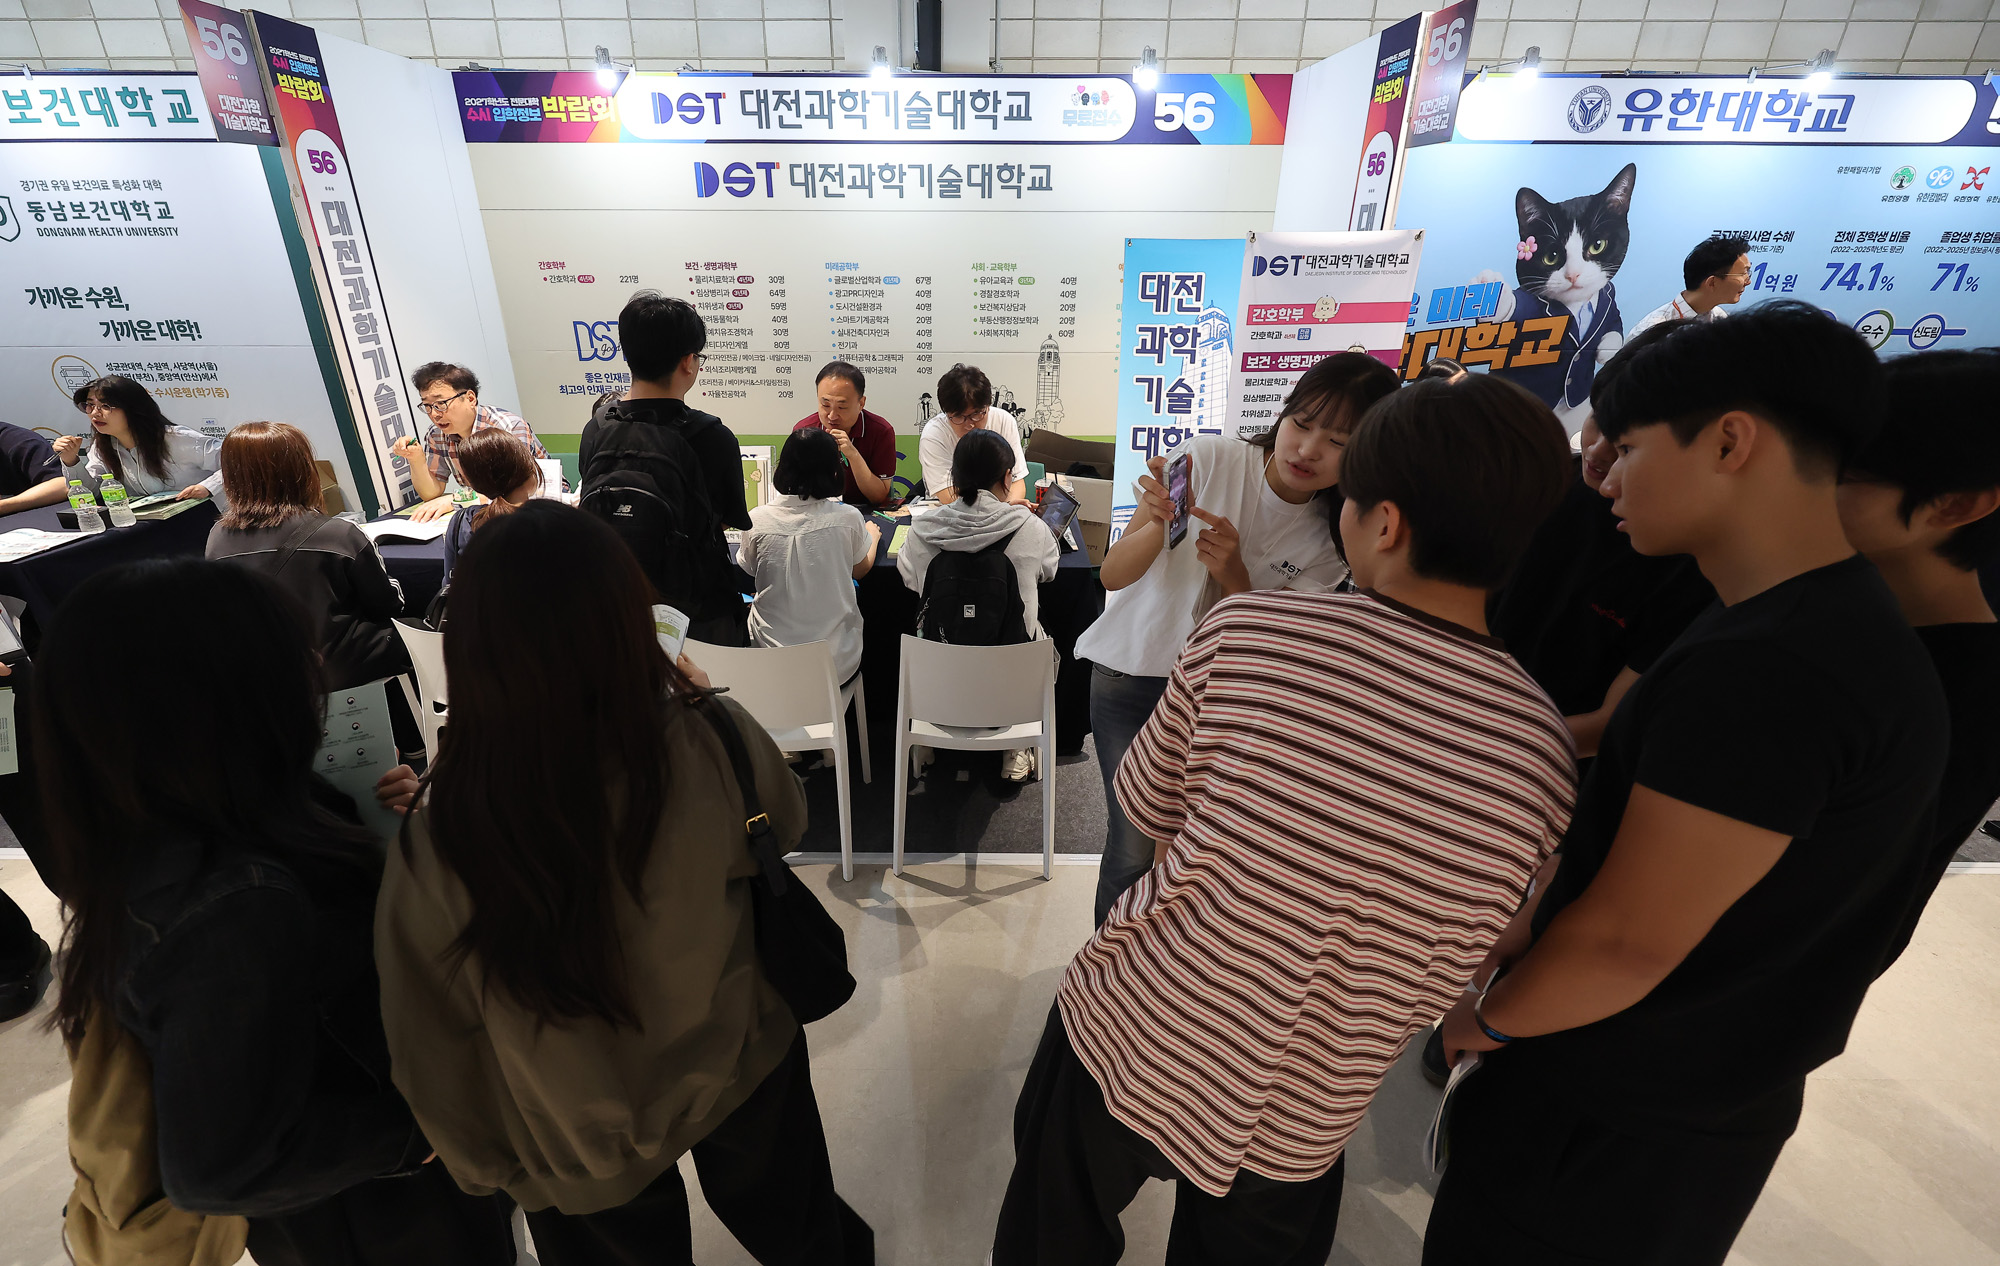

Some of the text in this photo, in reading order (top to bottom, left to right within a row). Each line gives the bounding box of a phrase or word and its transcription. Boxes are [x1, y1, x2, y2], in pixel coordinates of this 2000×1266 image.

[195, 16, 248, 65] 56
[1428, 18, 1465, 67] 56
[273, 56, 320, 77] 수시 입학정보
[1378, 65, 1389, 79] 수시
[276, 73, 325, 103] 박람회
[1374, 75, 1405, 105] 박람회
[2, 87, 200, 128] 보건대학교
[218, 94, 262, 116] 대전과학
[510, 98, 540, 107] 전문대학
[1418, 94, 1449, 117] 대전과학
[467, 107, 542, 122] 수시 입학정보
[541, 96, 617, 123] 박람회
[651, 88, 1032, 130] DST 대전과학기술대학교
[1153, 92, 1216, 132] 56
[1617, 88, 1855, 132] 유한대학교
[219, 113, 271, 134] 기술대학교
[1063, 109, 1121, 127] 무료접수
[1413, 112, 1450, 135] 기술대학교
[307, 149, 337, 174] 56
[1367, 152, 1386, 177] 56
[20, 180, 163, 192] 경기권 유일 보건의료 특성화 대학
[694, 161, 1053, 199] DST 대전과학기술대학교
[26, 200, 174, 222] 동남보건대학교
[36, 227, 179, 237] DONGNAM HEALTH UNIVERSITY
[1773, 230, 1795, 243] 수혜
[1834, 230, 1911, 243] 전체 장학생 비율
[1940, 231, 1973, 244] 졸업생
[1769, 245, 1785, 254] 기준)
[1889, 245, 1905, 254] 평균)
[538, 261, 566, 270] 간호학부
[685, 262, 738, 271] 보건 생명과학부
[825, 262, 859, 271] 미래공학부
[971, 263, 1018, 271] 사회 교육학부
[1252, 253, 1410, 277] DST 대전과학기술대학교
[549, 275, 576, 284] 간호학과
[619, 275, 639, 284] 221명
[695, 276, 735, 284] 물리치료학과
[769, 276, 785, 284] 30명
[834, 276, 932, 285] 글로벌산업학과 67명
[979, 277, 1078, 285] 유아교육과 40명
[1781, 273, 1798, 293] 원
[1820, 262, 1895, 292] 74.1%
[1930, 262, 1980, 292] 71%
[25, 286, 130, 311] 가까운 수원,
[696, 289, 786, 298] 임상병리과 64명
[835, 290, 932, 298] 광고PR디자인과 40명
[979, 290, 1077, 299] 경찰경호학과 40명
[1139, 273, 1204, 314] 대전
[698, 302, 787, 310] 치위생과 59명
[836, 303, 932, 311] 도시건설환경과 40명
[979, 303, 1076, 312] 보건복지상담과 20명
[1426, 281, 1504, 324] 미래
[772, 315, 788, 323] 40명
[837, 316, 932, 325] 스마트기계공학과 20명
[979, 316, 1075, 325] 부동산행정정보학과 20명
[1252, 308, 1305, 322] 간호학부
[99, 319, 203, 341] 가까운 대학!
[706, 328, 789, 336] 예치유조경학과 30명
[837, 329, 932, 337] 실내건축디자인과 40명
[979, 329, 1075, 338] 사회복지학과 60명
[1251, 330, 1282, 340] 간호학과
[1914, 326, 1940, 339] 신도림
[774, 341, 790, 349] 80명
[838, 341, 932, 350] 전기과 40명
[1135, 325, 1202, 365] 과학
[1398, 315, 1570, 380] 대학교
[917, 354, 933, 362] 40명
[1246, 356, 1271, 369] 보건
[147, 362, 173, 372] 수원역,
[173, 362, 218, 372] 사당역(서울)
[776, 366, 792, 374] 60명
[917, 366, 933, 375] 40명
[585, 372, 631, 383] 좋은 인재를
[1245, 378, 1288, 386] 물리치료학과
[155, 387, 230, 398] 수시운행(학기중)
[559, 385, 586, 395] 최고의
[708, 390, 794, 398] 자율전공학과 20명
[1135, 376, 1196, 416] 기술
[1243, 394, 1282, 402] 임상병리과
[1241, 410, 1272, 418] 치위생과
[1281, 560, 1302, 576] DST
